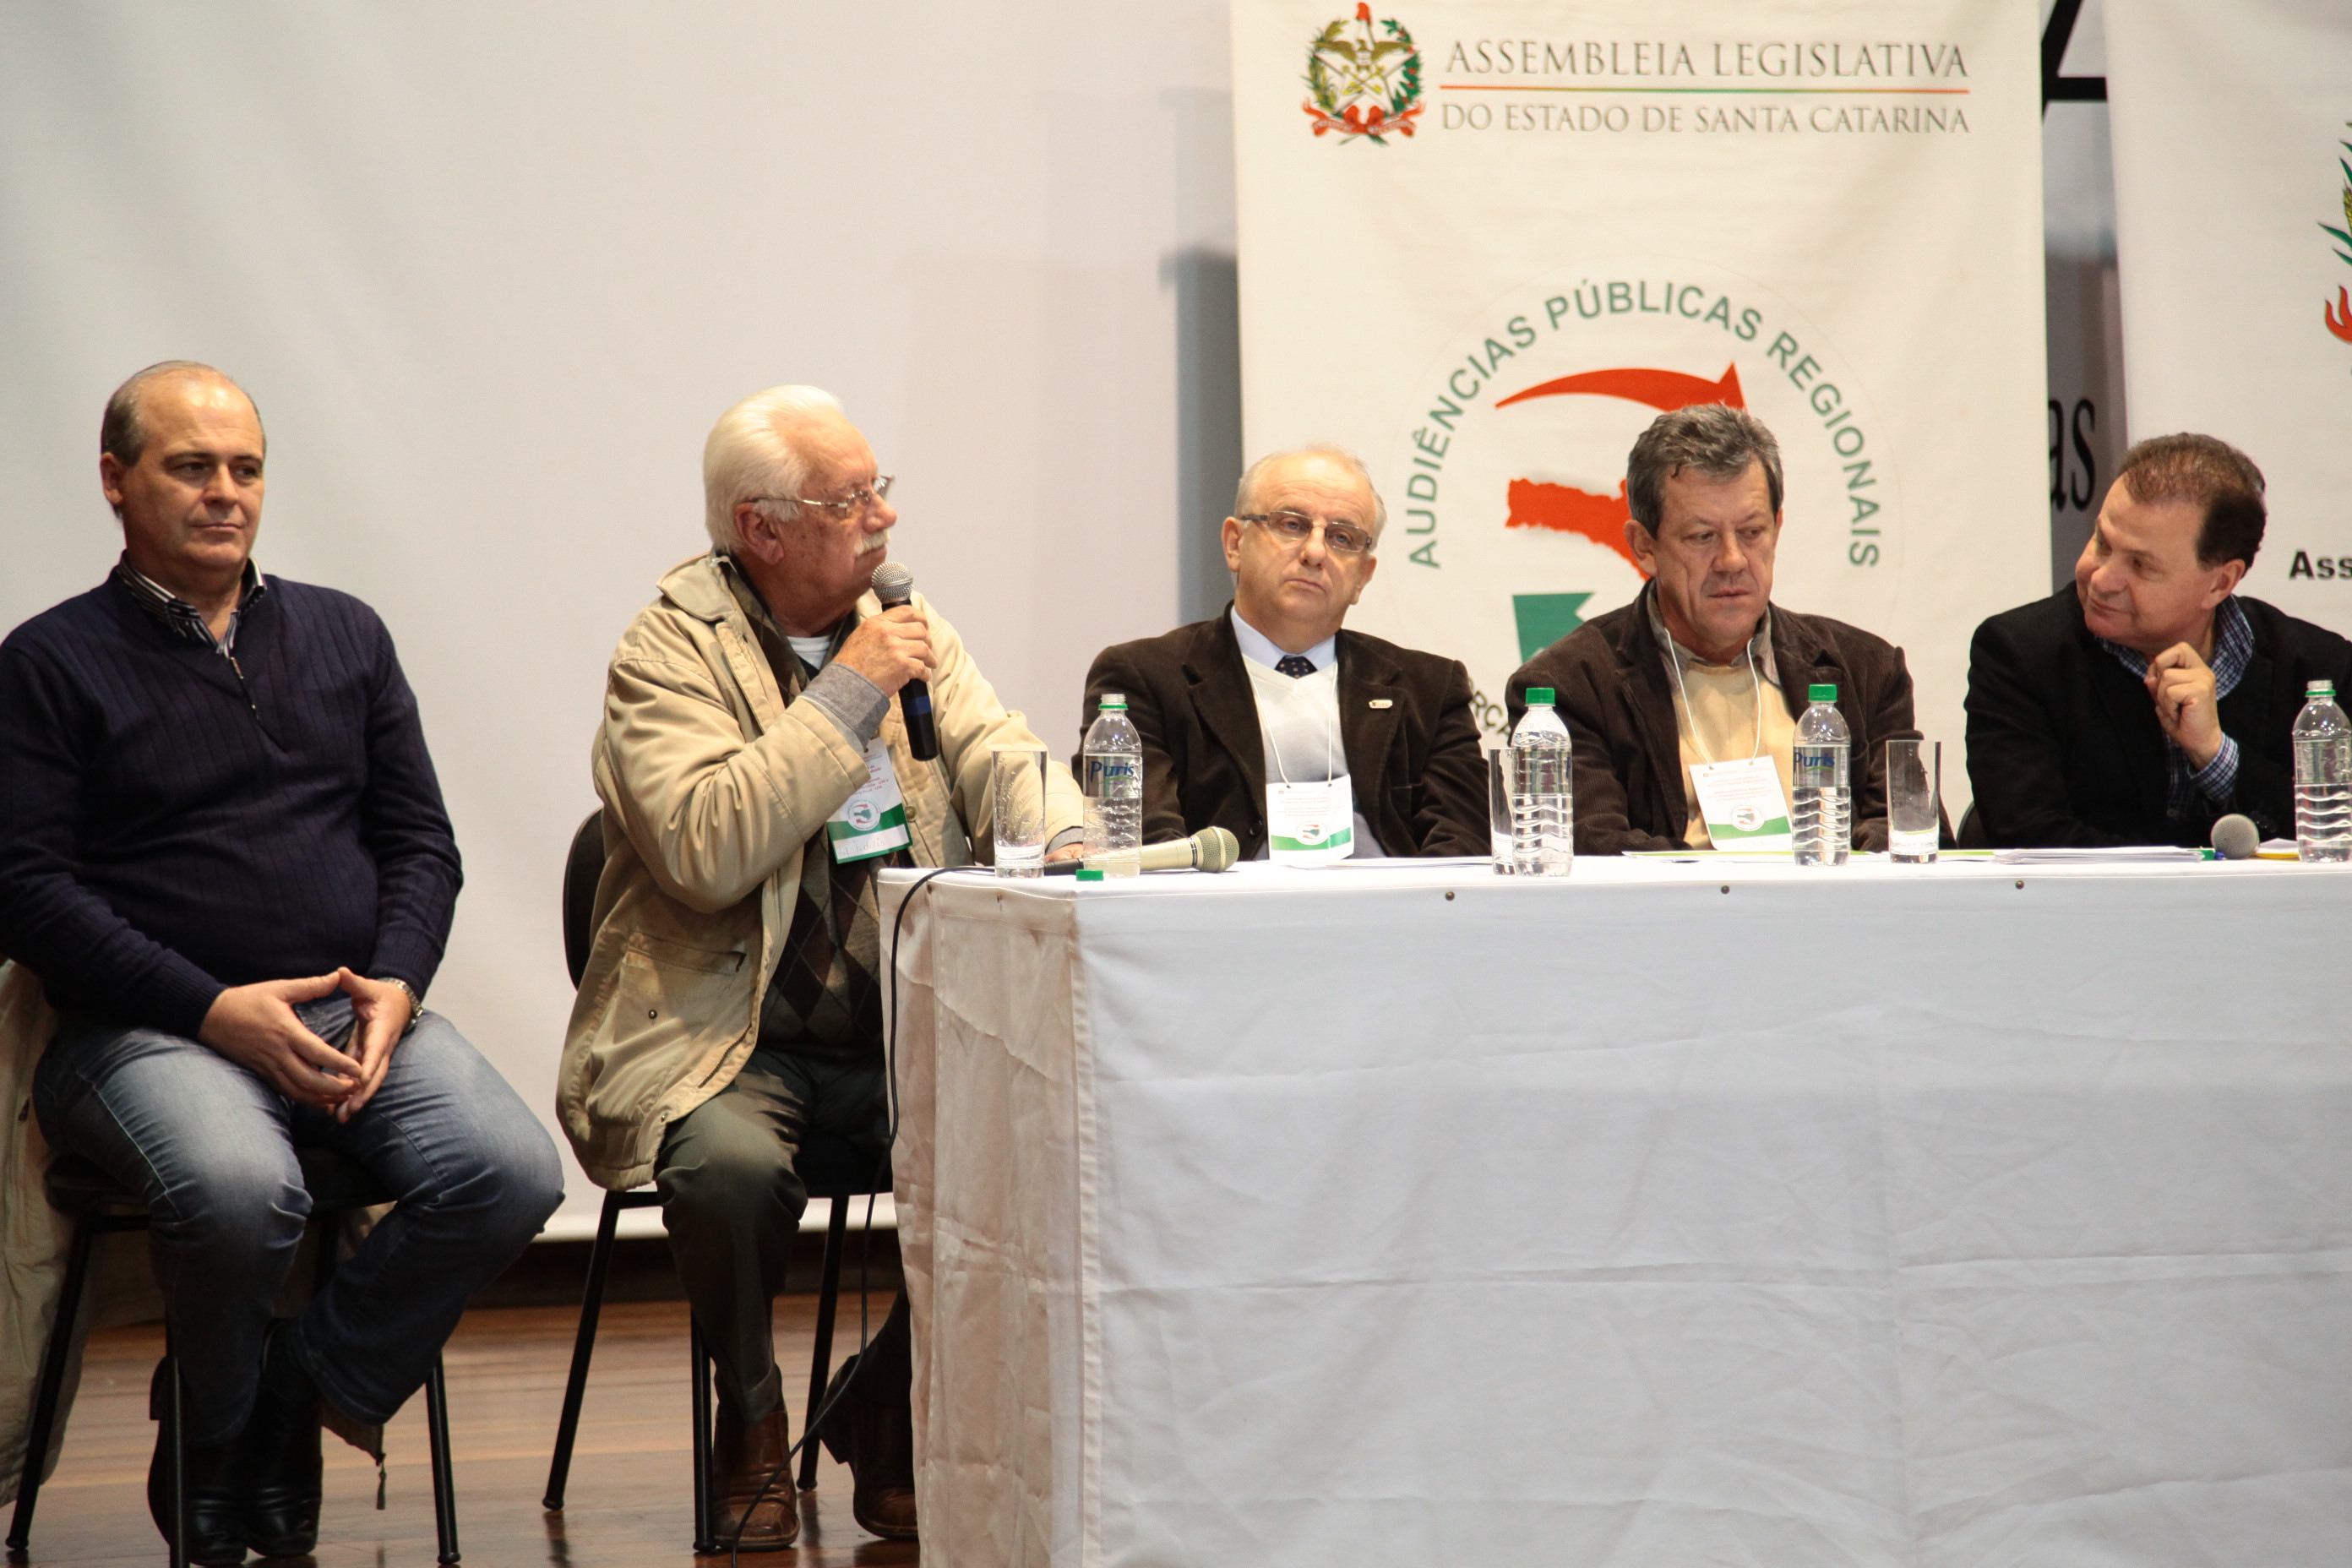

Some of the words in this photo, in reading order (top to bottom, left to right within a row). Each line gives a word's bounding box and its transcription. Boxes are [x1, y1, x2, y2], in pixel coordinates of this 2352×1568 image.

[1445, 38, 1696, 77] ASSEMBLEIA
[1712, 41, 1969, 78] LEGISLATIVA
[1441, 103, 1493, 132] DO
[1504, 104, 1630, 133] ESTADO
[1641, 106, 1683, 133] DE
[1694, 106, 1799, 133] SANTA
[1808, 106, 1970, 133] CATARINA
[1406, 314, 1536, 569] AUDIÊNCIAS
[1544, 279, 1762, 341] PÚBLICAS
[1767, 331, 1880, 567] REGIONAIS
[1090, 761, 1135, 783] Puris
